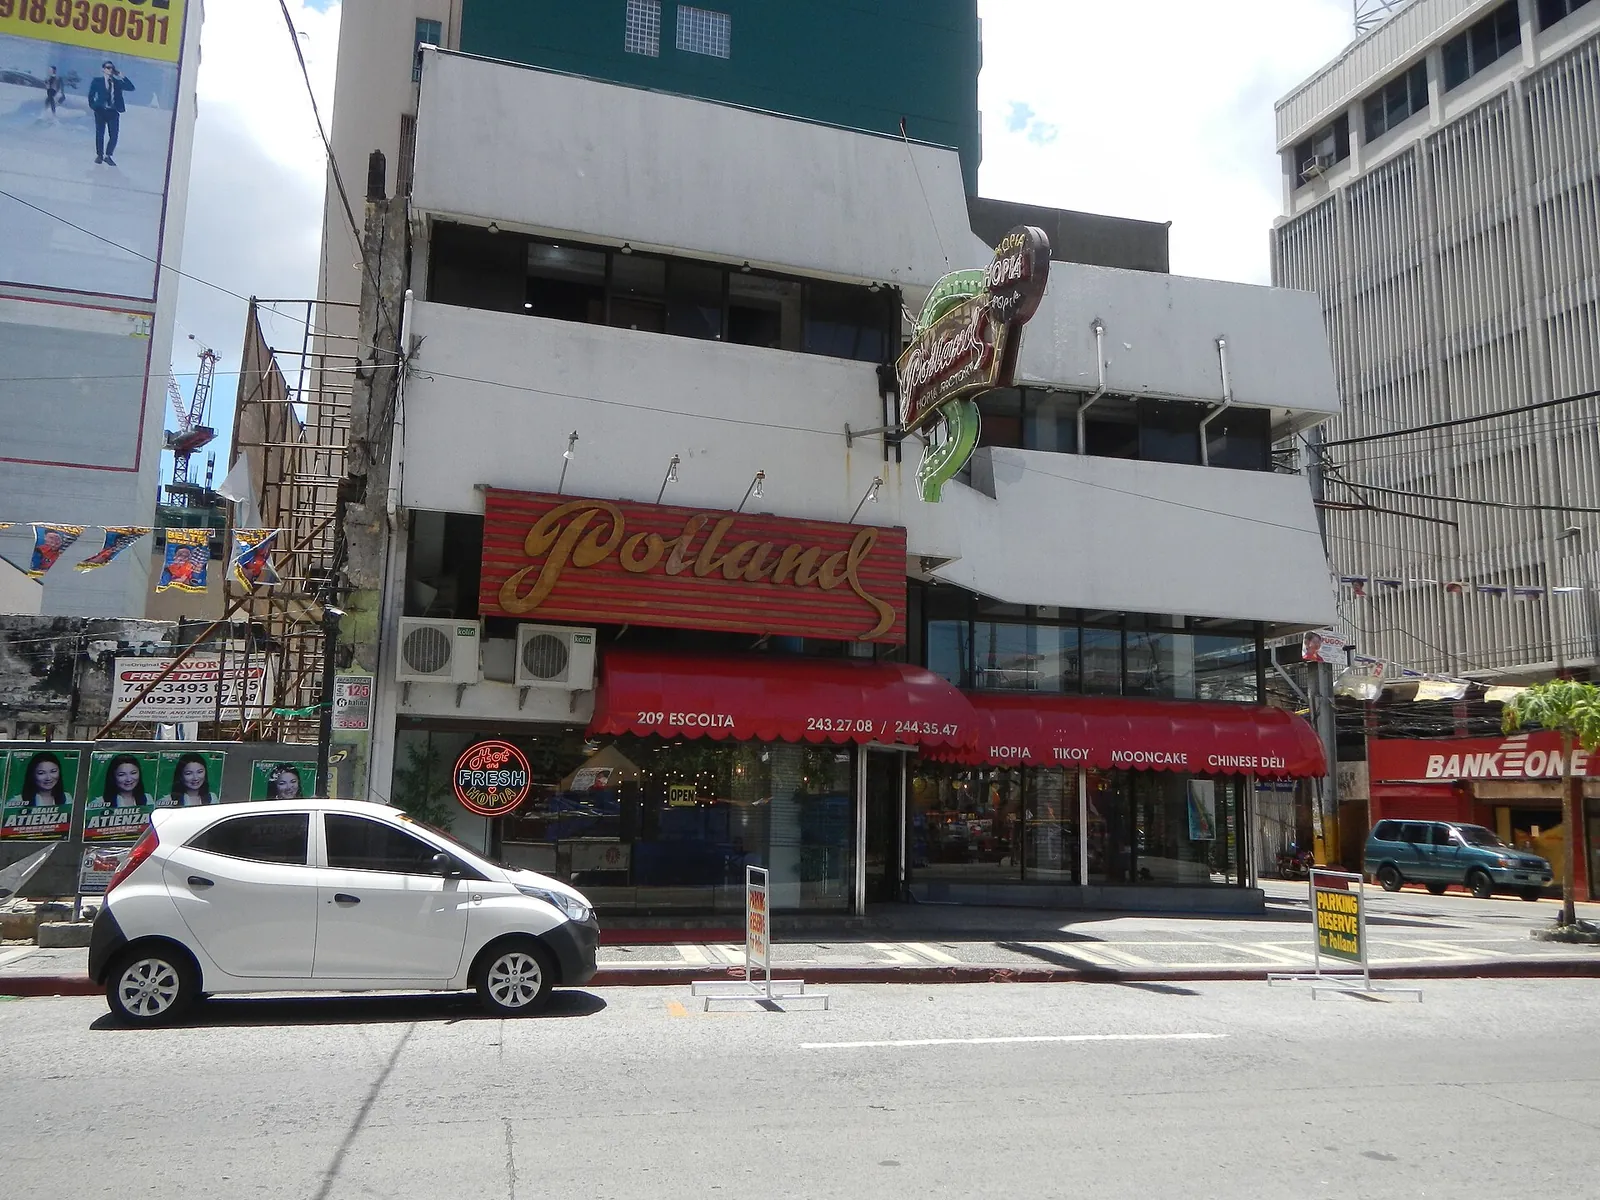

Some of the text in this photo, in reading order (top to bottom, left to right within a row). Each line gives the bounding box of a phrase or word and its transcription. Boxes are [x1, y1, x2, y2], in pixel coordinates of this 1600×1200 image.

[983, 255, 1023, 287] HOPIA
[900, 306, 984, 425] Polland
[916, 363, 976, 410] HOPIA FACTORY
[499, 499, 896, 641] Polland
[457, 628, 475, 636] kolin
[574, 635, 592, 643] kolin
[130, 672, 174, 681] FREE
[347, 684, 369, 697] 125
[142, 695, 191, 705] (0923)
[637, 711, 735, 728] 209 ESCOLTA
[807, 717, 958, 736] 243.27.08 / 244.35.47
[469, 747, 510, 770] Hot
[990, 746, 1032, 759] HOPIA
[1053, 747, 1090, 760] TIKOY
[1111, 750, 1188, 765] MOONCAKE
[1207, 754, 1286, 769] CHINESE DELI
[1425, 750, 1590, 778] BANK ONE
[459, 769, 526, 786] FRESH
[465, 786, 517, 807] HOPIA
[670, 788, 695, 802] OPEN
[31, 806, 60, 815] MAILE
[114, 807, 141, 815] MAILE
[5, 812, 69, 828] ATIENZA
[87, 813, 150, 829] ATIENZA
[1317, 891, 1358, 914] PARKING
[1317, 910, 1358, 935] RESERVE
[1329, 931, 1358, 954] Polland
